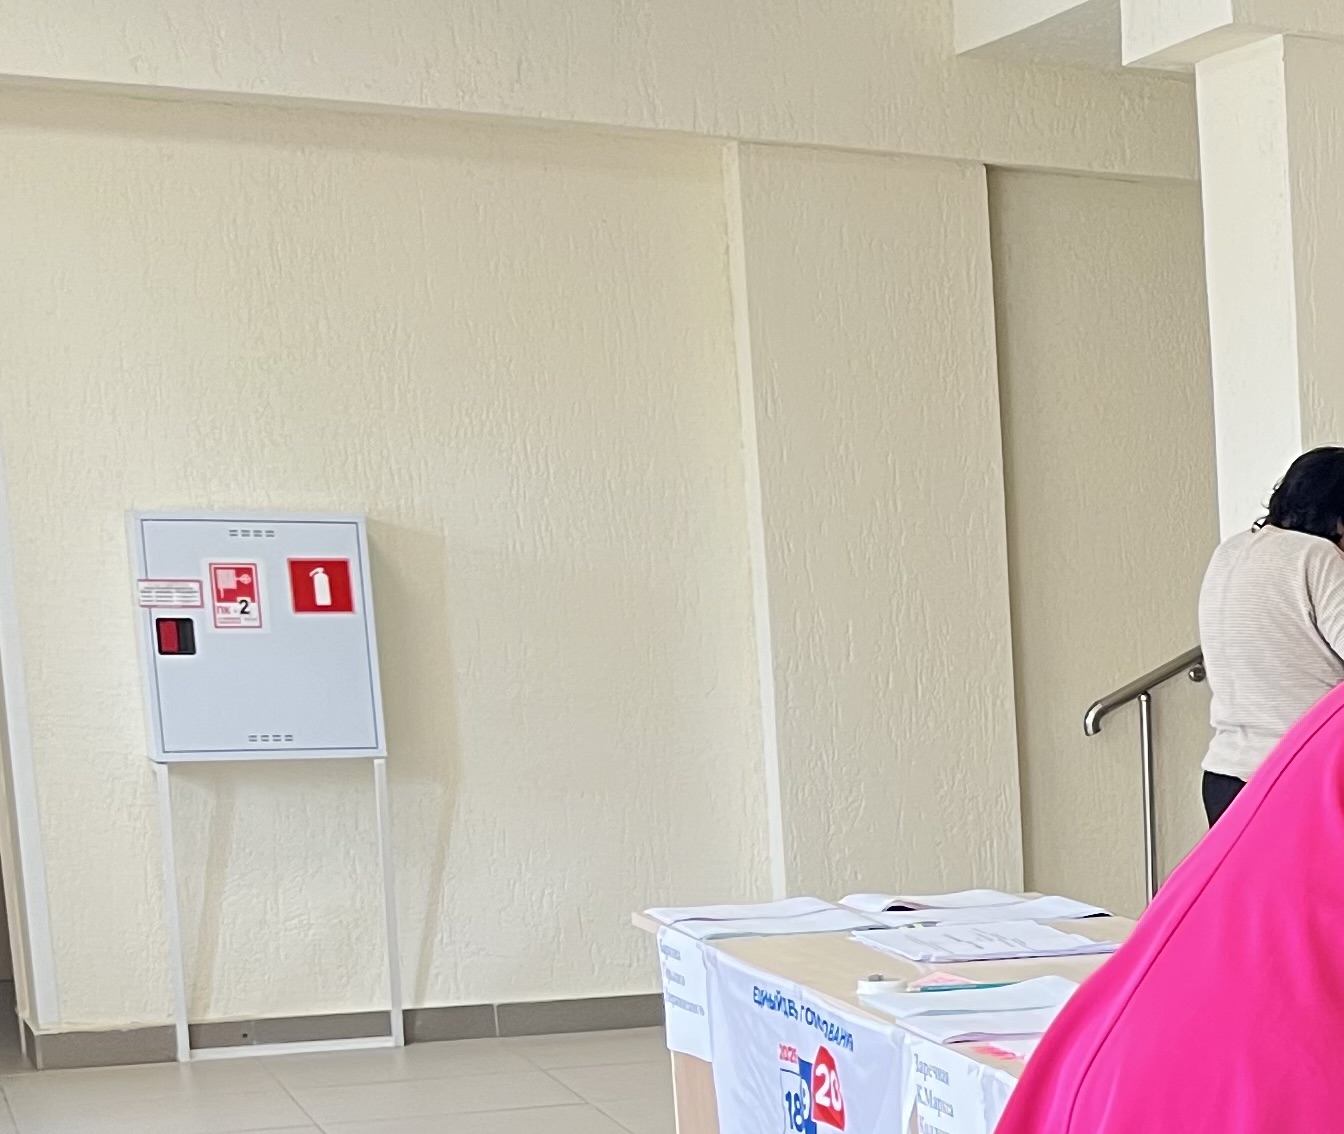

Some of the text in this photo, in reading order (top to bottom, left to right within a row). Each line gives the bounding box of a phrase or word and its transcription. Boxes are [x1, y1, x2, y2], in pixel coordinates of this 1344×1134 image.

[238, 599, 250, 615] 2
[785, 1090, 803, 1132] 18
[815, 1063, 842, 1112] 20
